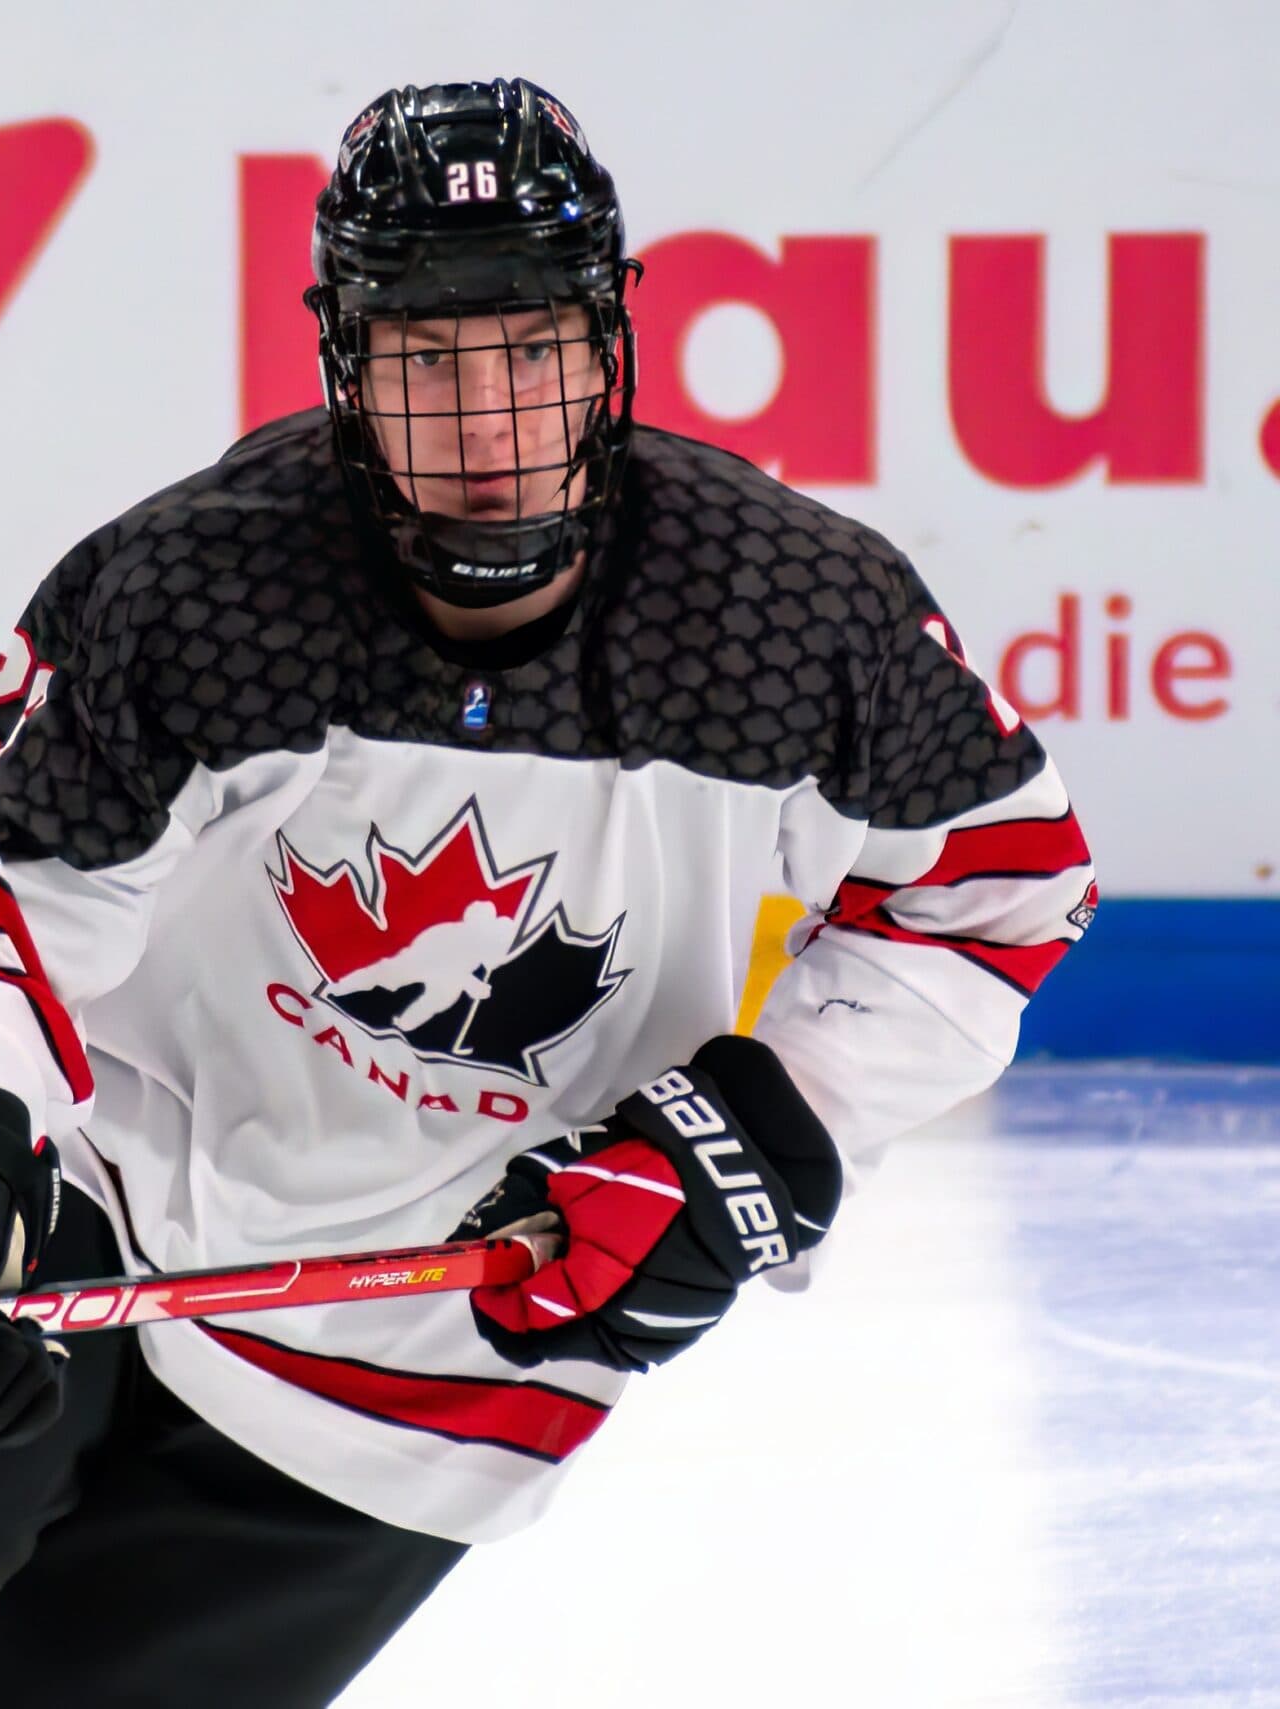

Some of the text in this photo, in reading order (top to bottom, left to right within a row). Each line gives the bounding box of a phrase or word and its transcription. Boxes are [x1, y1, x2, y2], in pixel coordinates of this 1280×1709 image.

[447, 161, 497, 202] 26
[998, 593, 1232, 722] die
[266, 982, 529, 1123] CANAD
[348, 1267, 447, 1289] HYPERLITE
